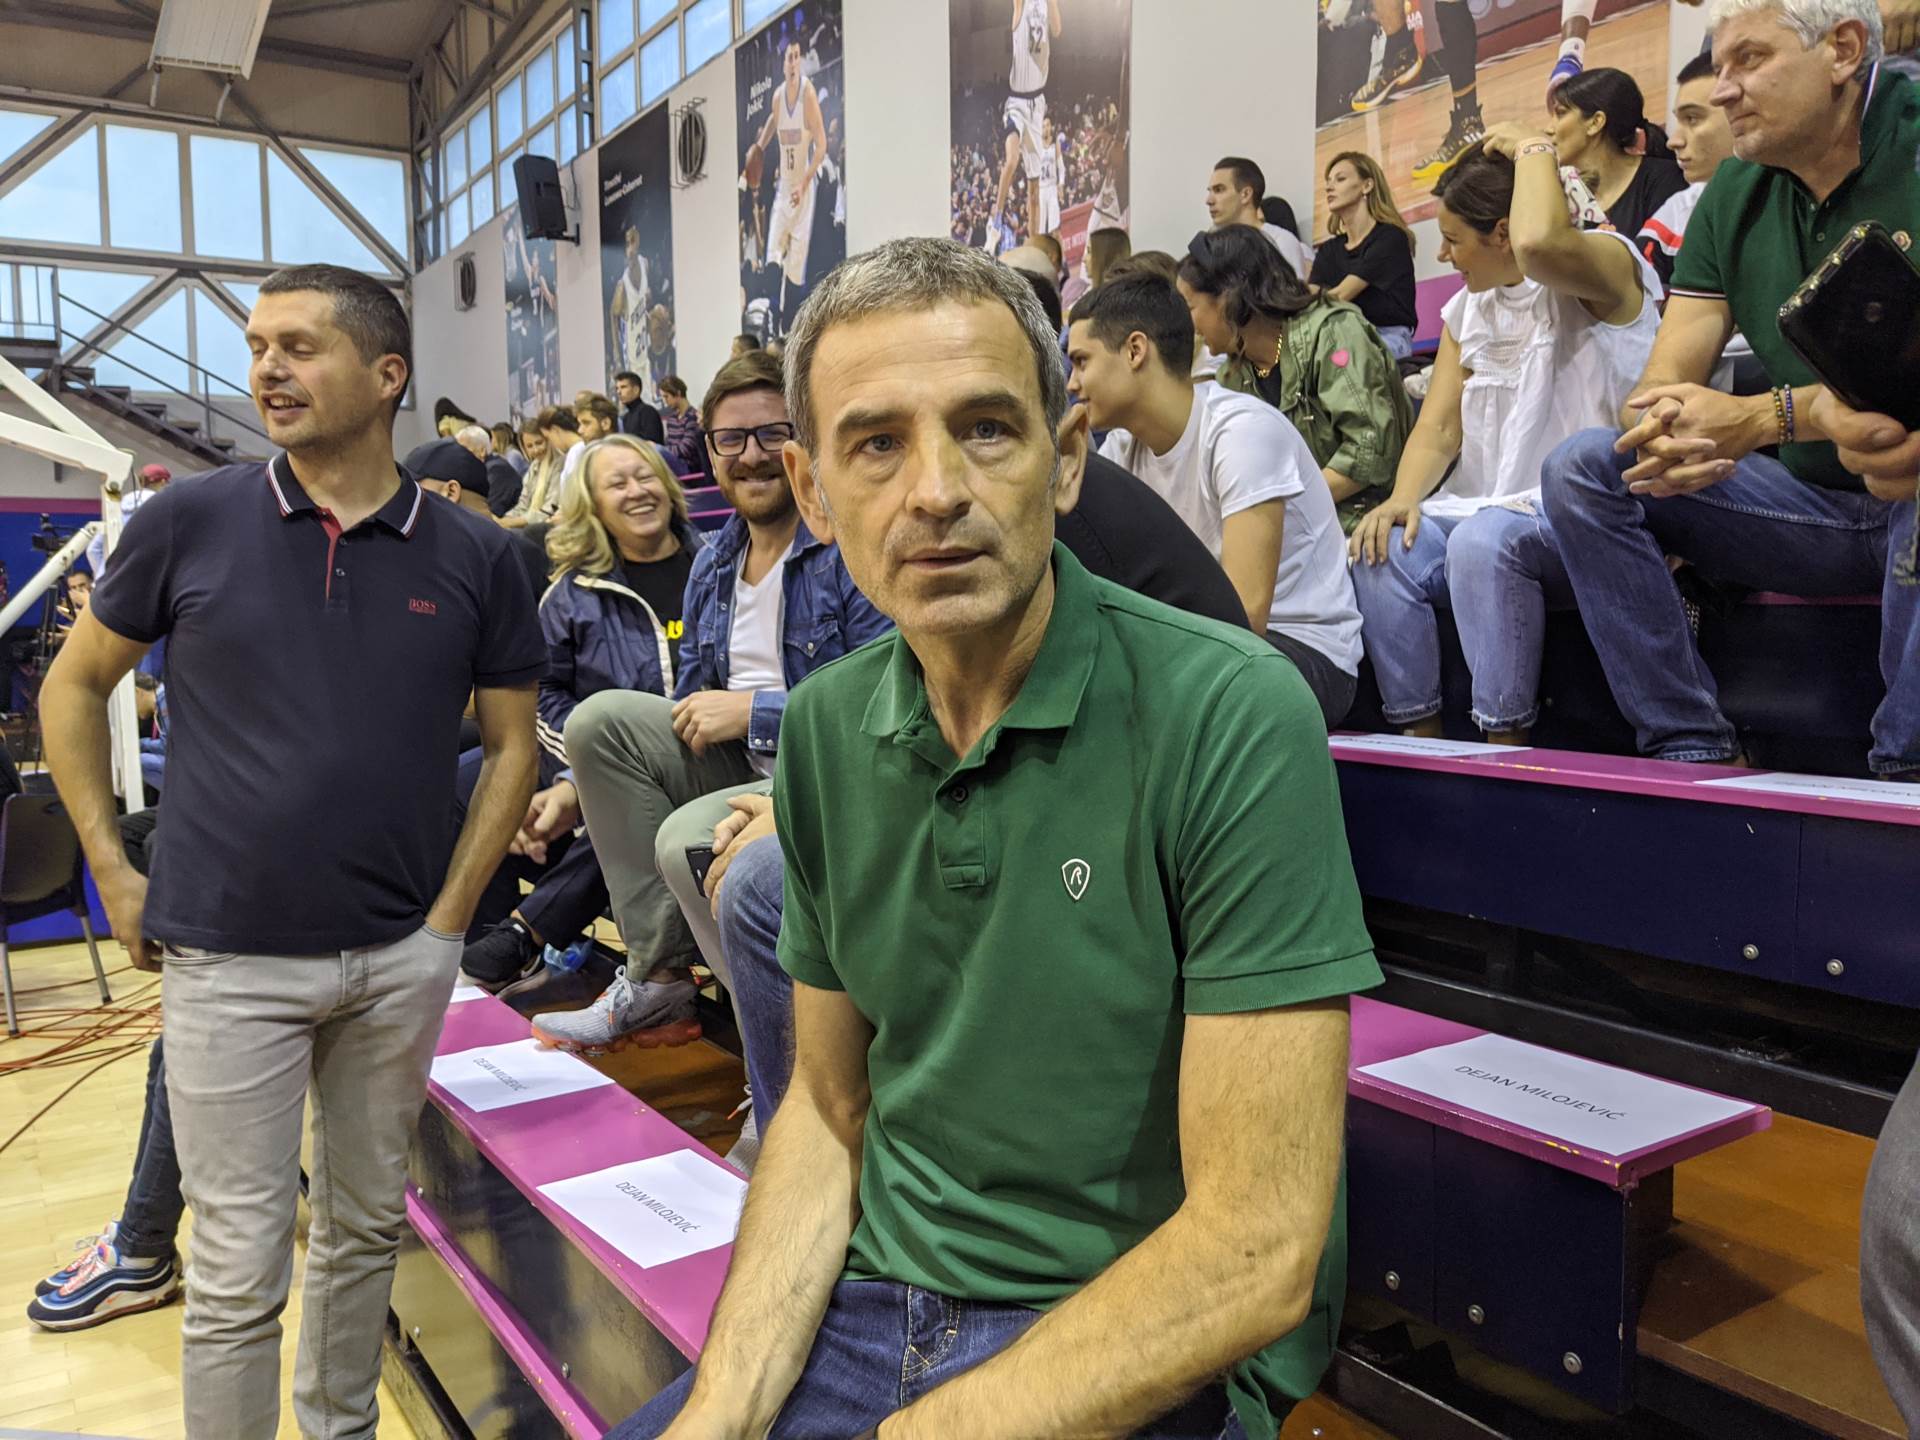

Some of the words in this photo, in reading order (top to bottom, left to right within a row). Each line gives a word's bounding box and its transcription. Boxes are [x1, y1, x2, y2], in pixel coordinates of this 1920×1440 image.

[786, 147, 797, 171] 15
[1454, 1065, 1517, 1087] DEJAN
[1515, 1084, 1626, 1120] MILOJEVIĆ
[616, 1181, 650, 1202] DEJAN
[642, 1199, 701, 1233] MILOJEVIĆ
